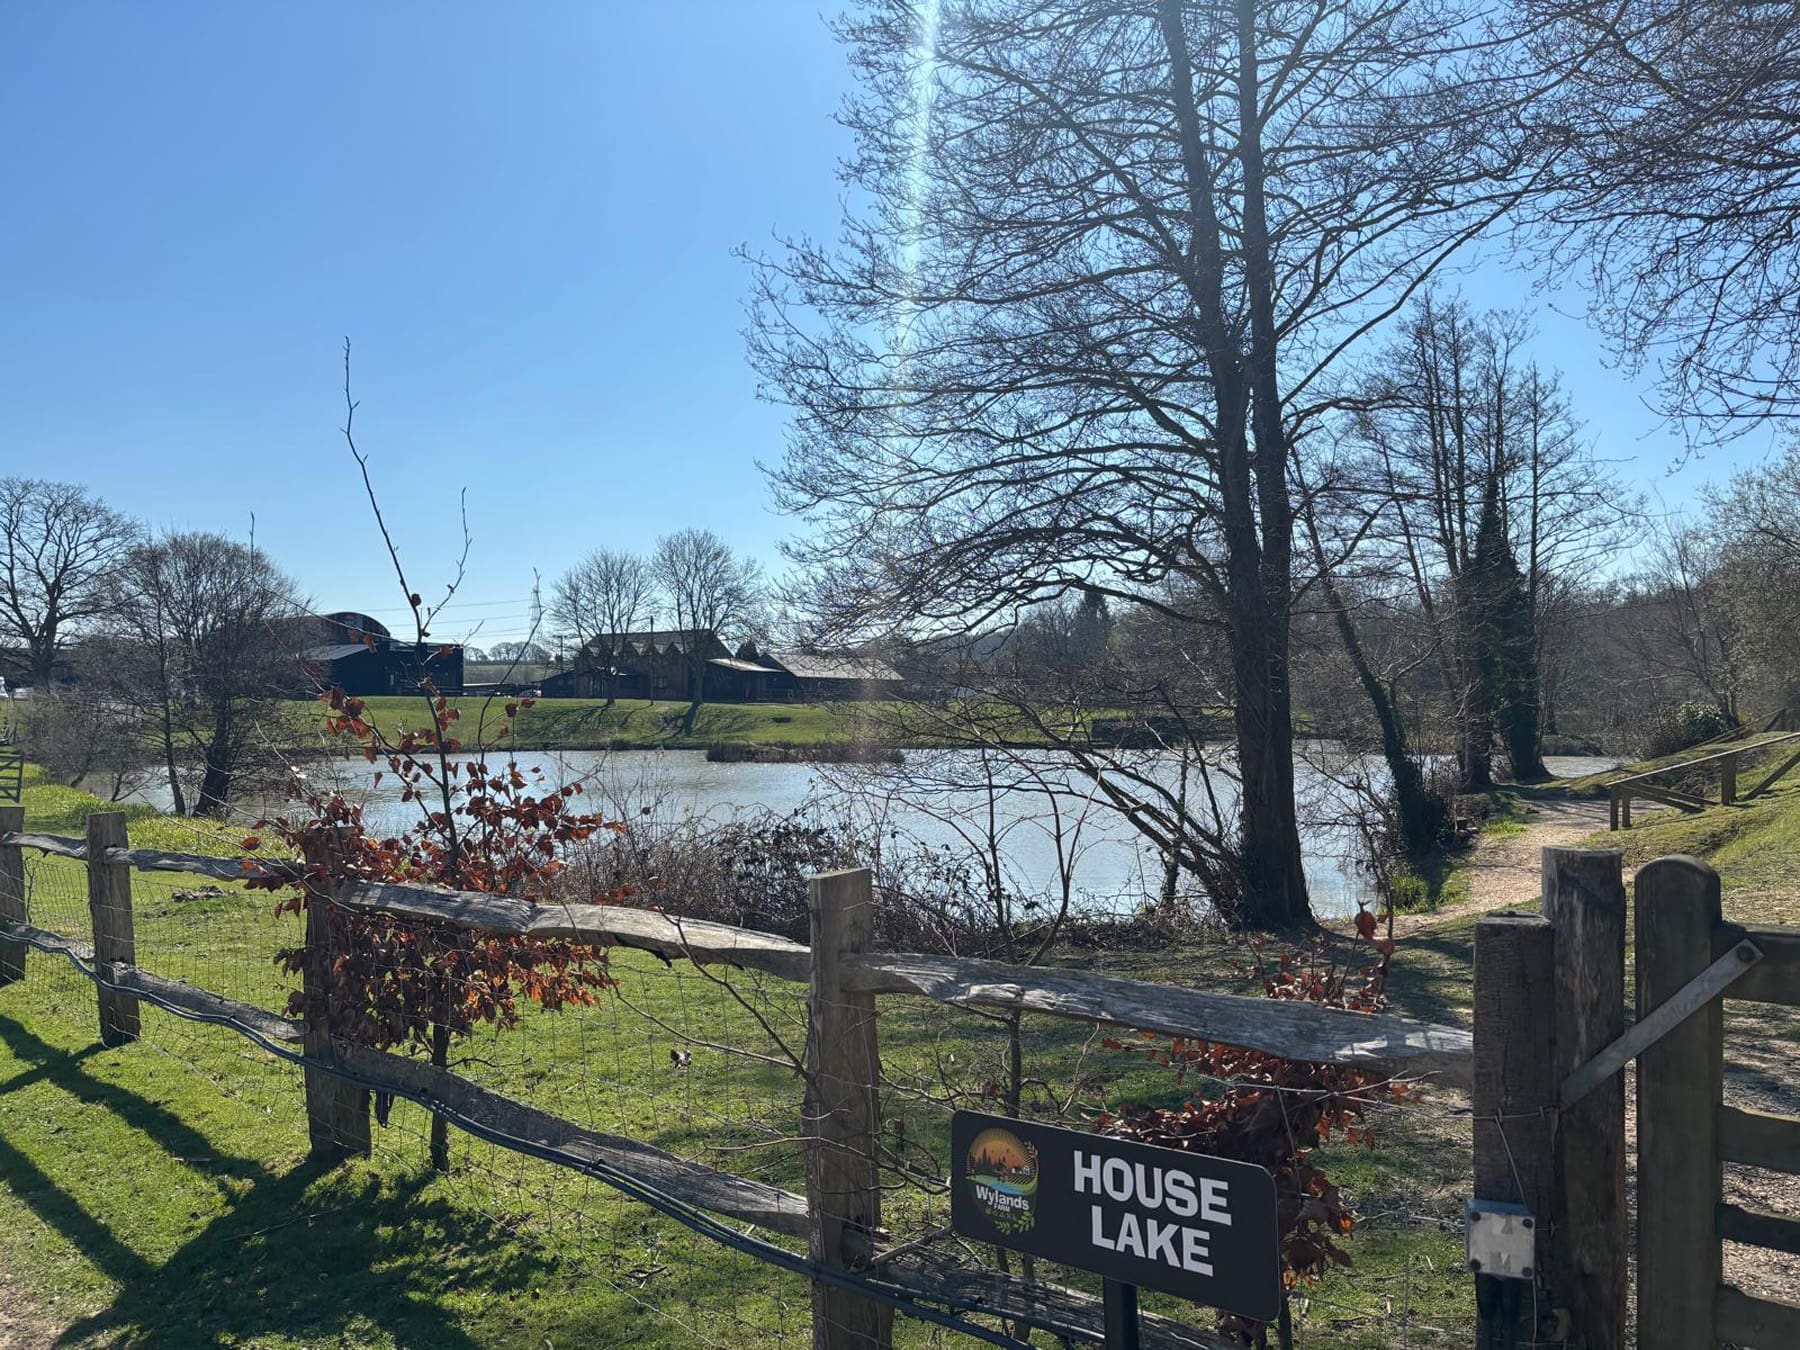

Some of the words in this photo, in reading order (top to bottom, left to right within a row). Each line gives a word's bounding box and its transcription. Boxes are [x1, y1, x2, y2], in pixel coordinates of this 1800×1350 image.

[975, 1185, 1030, 1211] Wylands
[1074, 1150, 1232, 1226] HOUSE
[1091, 1206, 1214, 1277] LAKE
